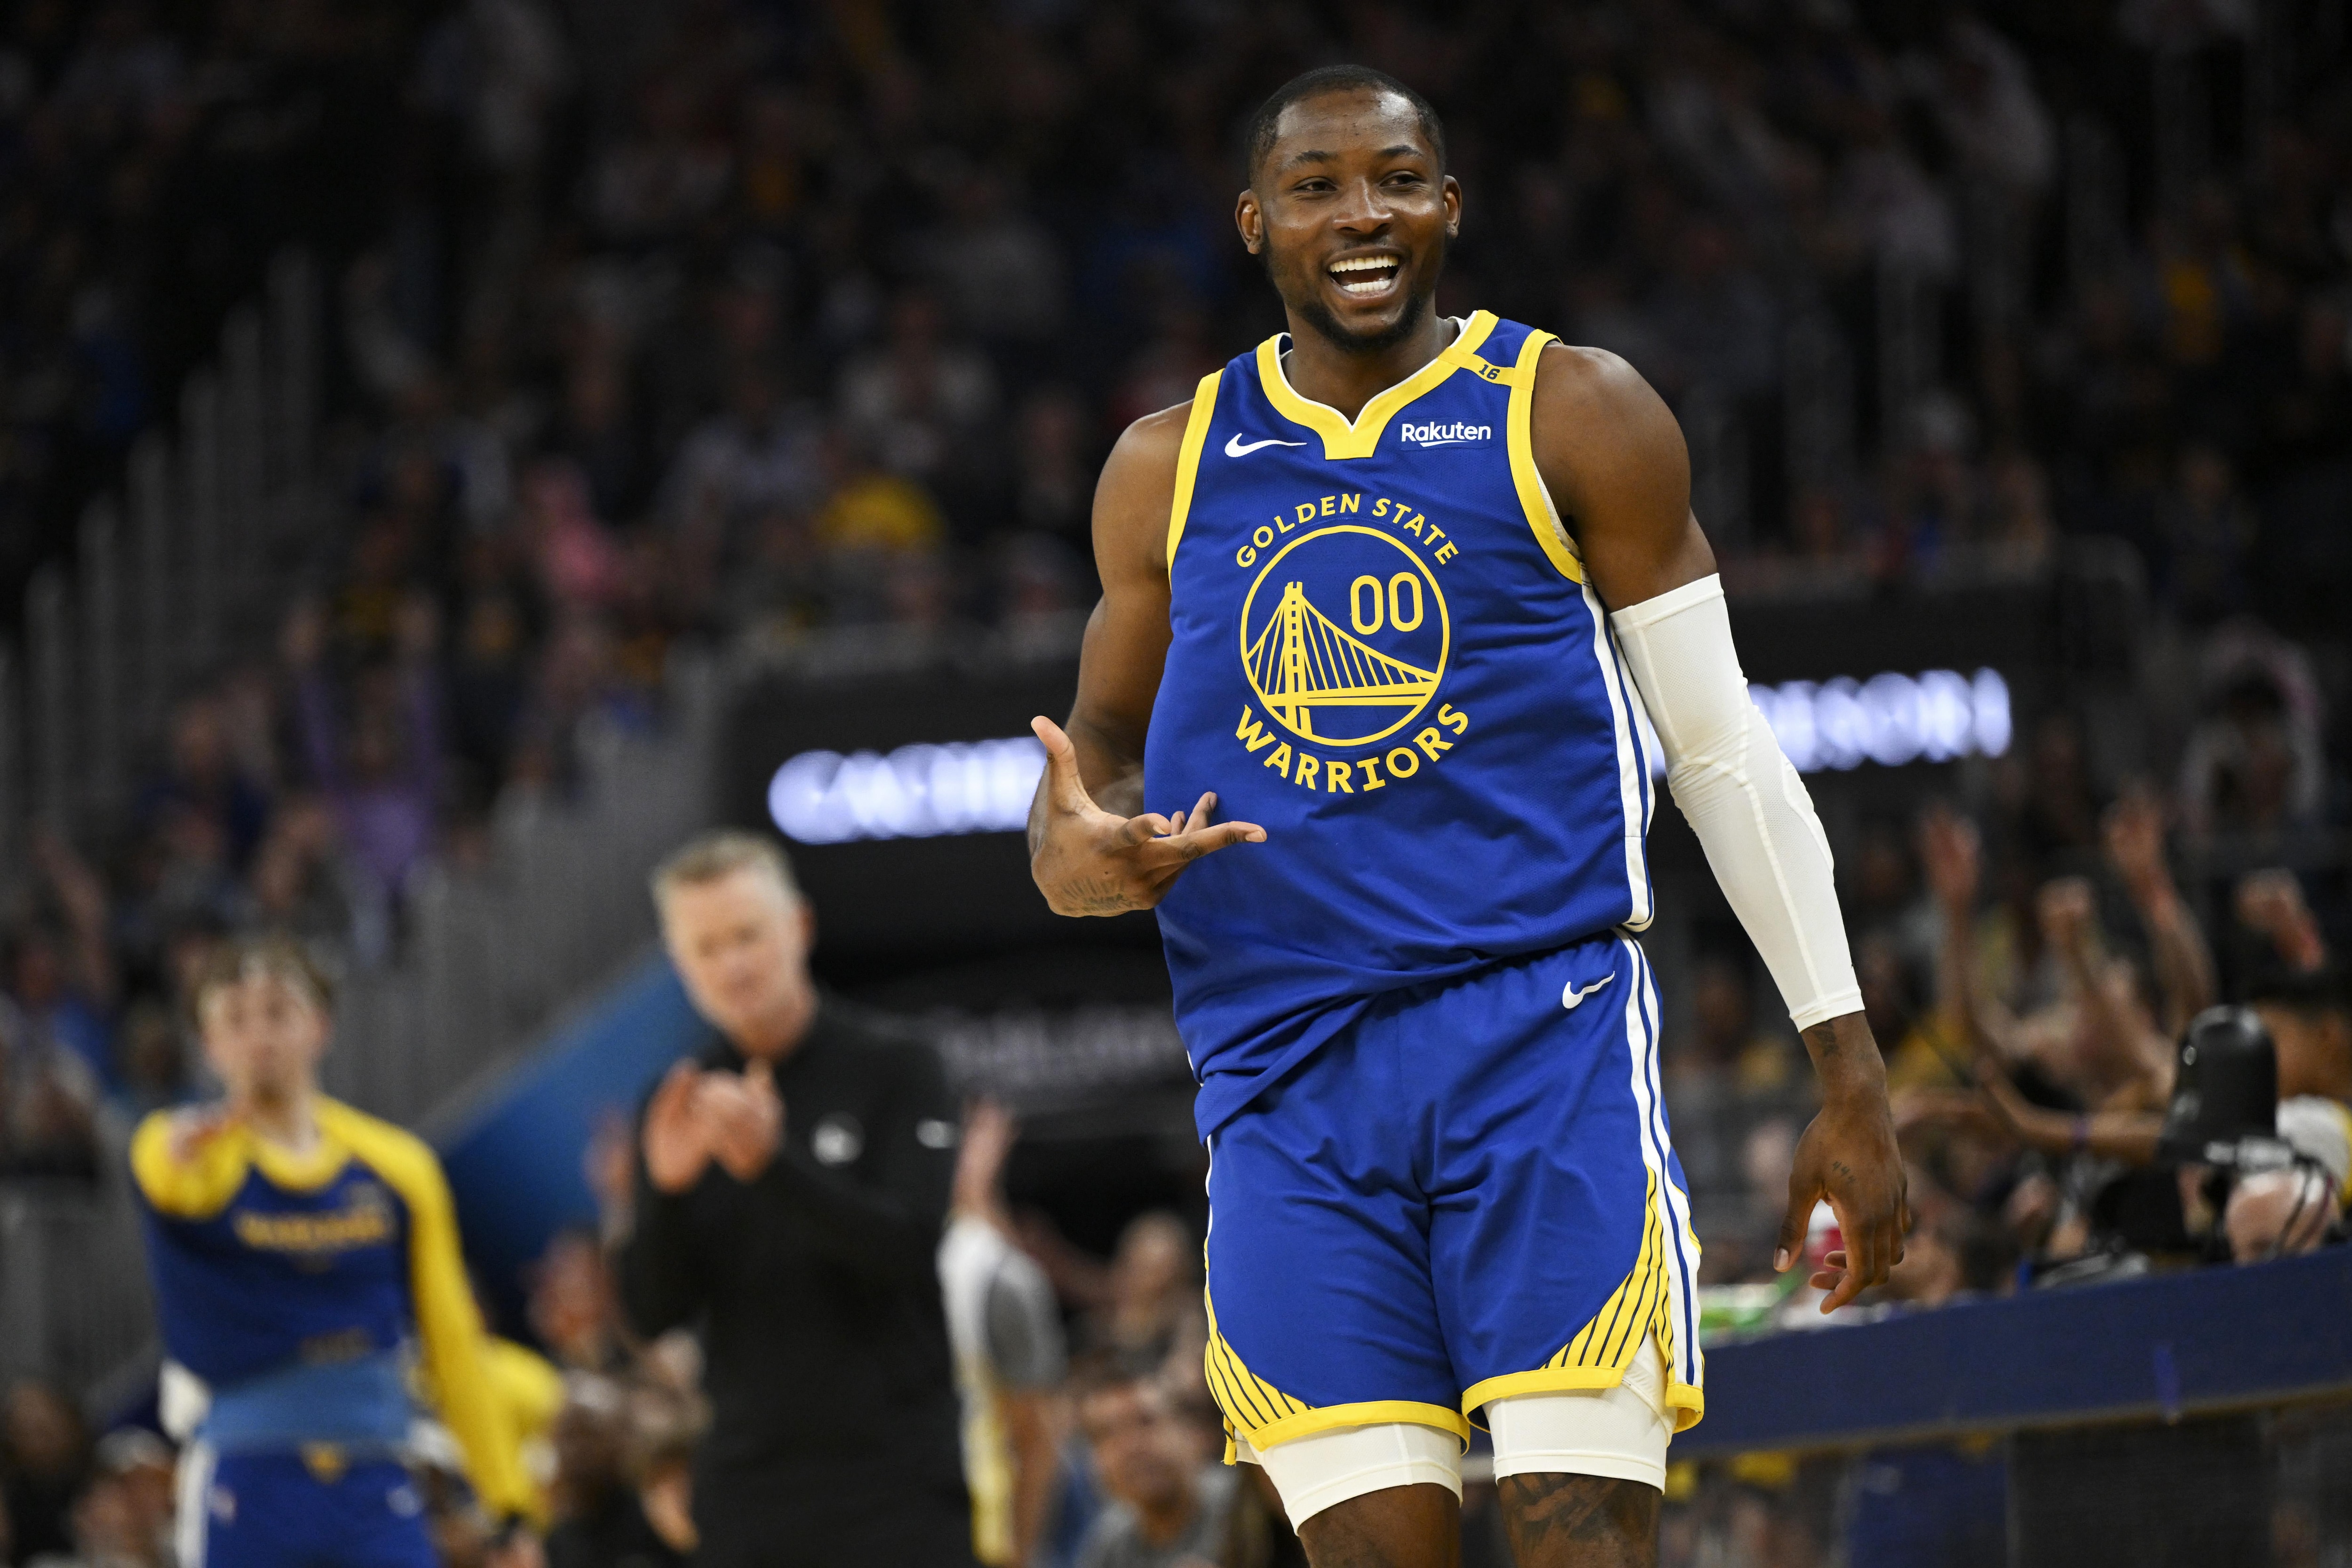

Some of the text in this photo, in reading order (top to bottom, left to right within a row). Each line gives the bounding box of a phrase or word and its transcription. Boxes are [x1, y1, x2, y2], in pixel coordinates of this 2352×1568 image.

[1478, 364, 1500, 380] 16
[1401, 421, 1491, 442] Rakuten
[1236, 493, 1459, 568] GOLDEN STATE
[1350, 572, 1423, 635] 00
[1235, 704, 1469, 793] WARRIORS
